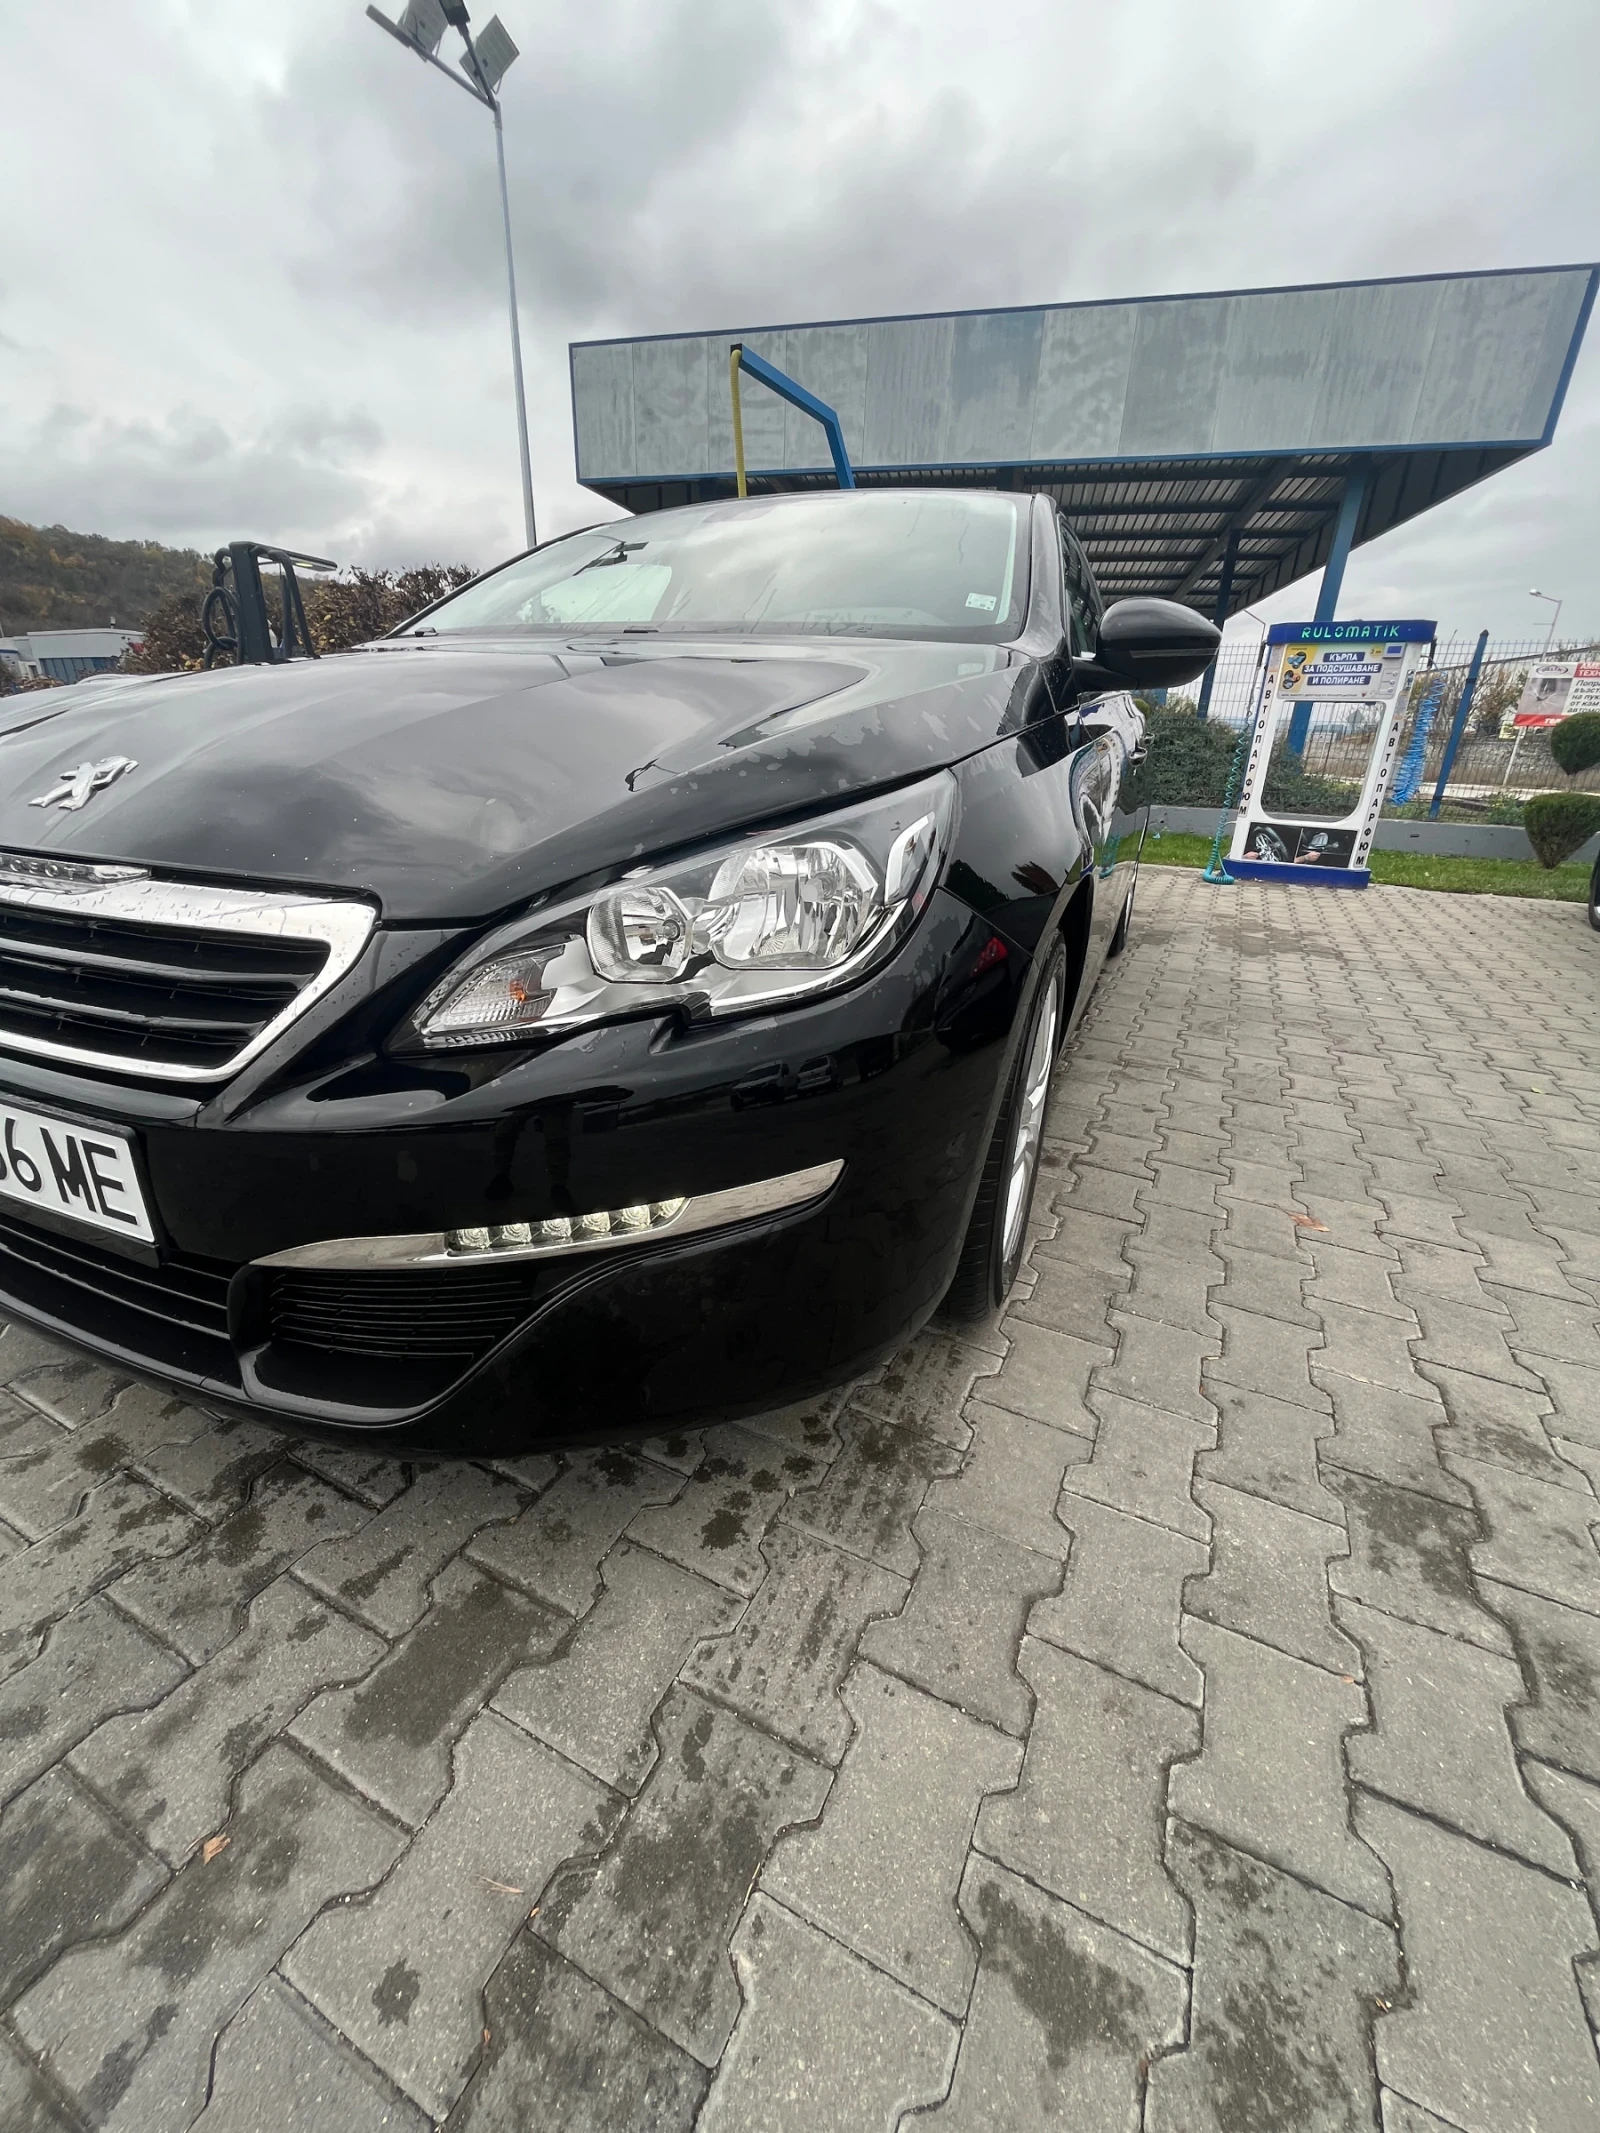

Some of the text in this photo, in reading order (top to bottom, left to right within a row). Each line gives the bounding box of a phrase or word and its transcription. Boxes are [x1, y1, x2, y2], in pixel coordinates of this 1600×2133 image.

[1302, 625, 1400, 639] RULOMATIK
[1329, 653, 1358, 661] КЪРПА
[1304, 664, 1379, 673] ЗА ПОДСУШАВАНЕ
[1320, 676, 1365, 684] ПОЛИРАНЕ
[1238, 674, 1274, 815] АВТОПАРФЮМ
[1355, 722, 1399, 865] АВТОПАРФЮМ
[39, 1127, 138, 1226] ME
